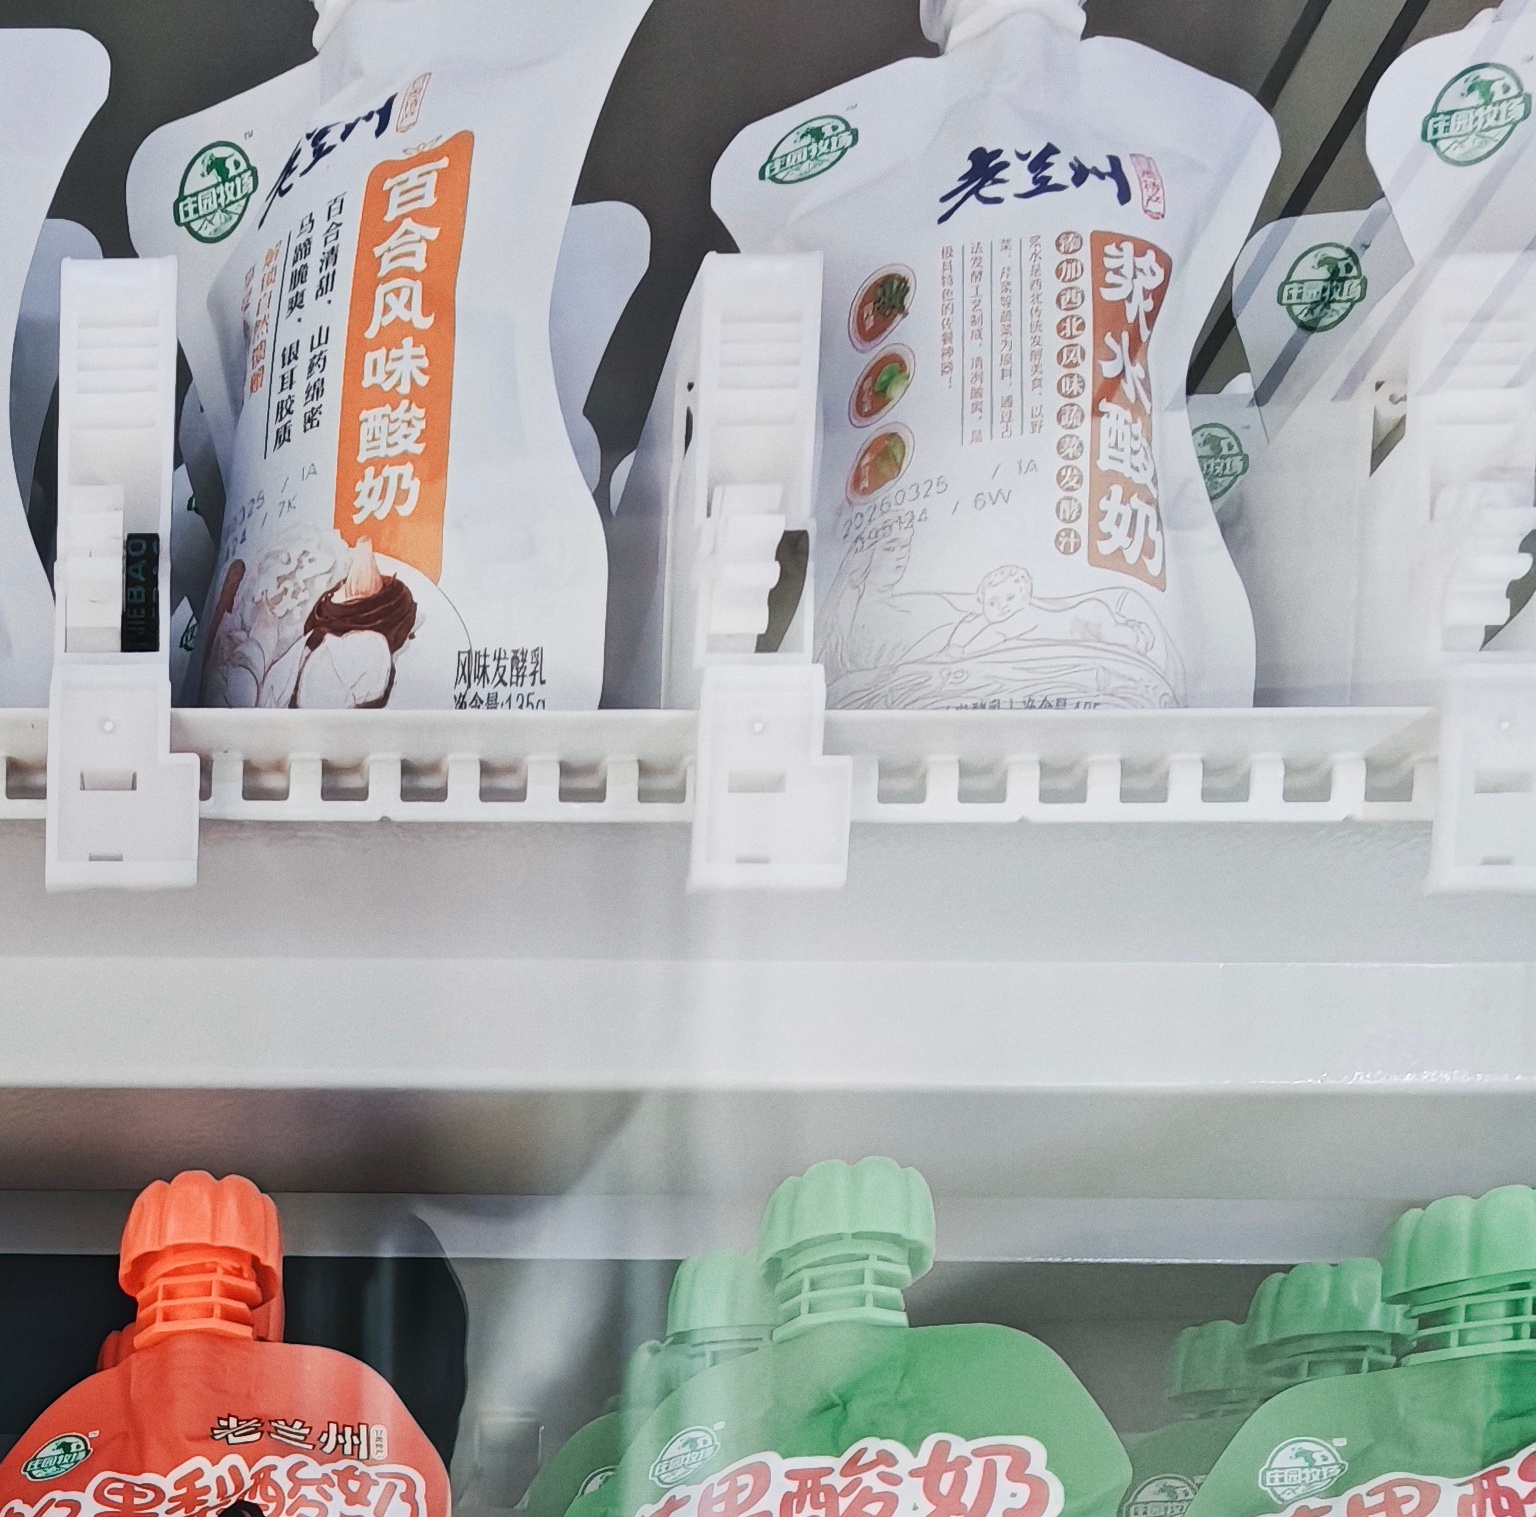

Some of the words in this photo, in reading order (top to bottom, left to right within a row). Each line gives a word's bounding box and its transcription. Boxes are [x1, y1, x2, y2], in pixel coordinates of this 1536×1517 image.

[1427, 99, 1527, 139] 庄园牧场
[179, 169, 257, 224] 庄园牧场
[937, 142, 1132, 225] 老兰州
[1281, 278, 1363, 304] 庄园牧场
[352, 156, 451, 525] 百合风味酸奶
[454, 647, 547, 689] 风味发酵乳
[209, 1413, 370, 1461] 老兰州
[656, 1446, 718, 1475] 庄园牧场
[1265, 1466, 1344, 1488] 庄园牧场
